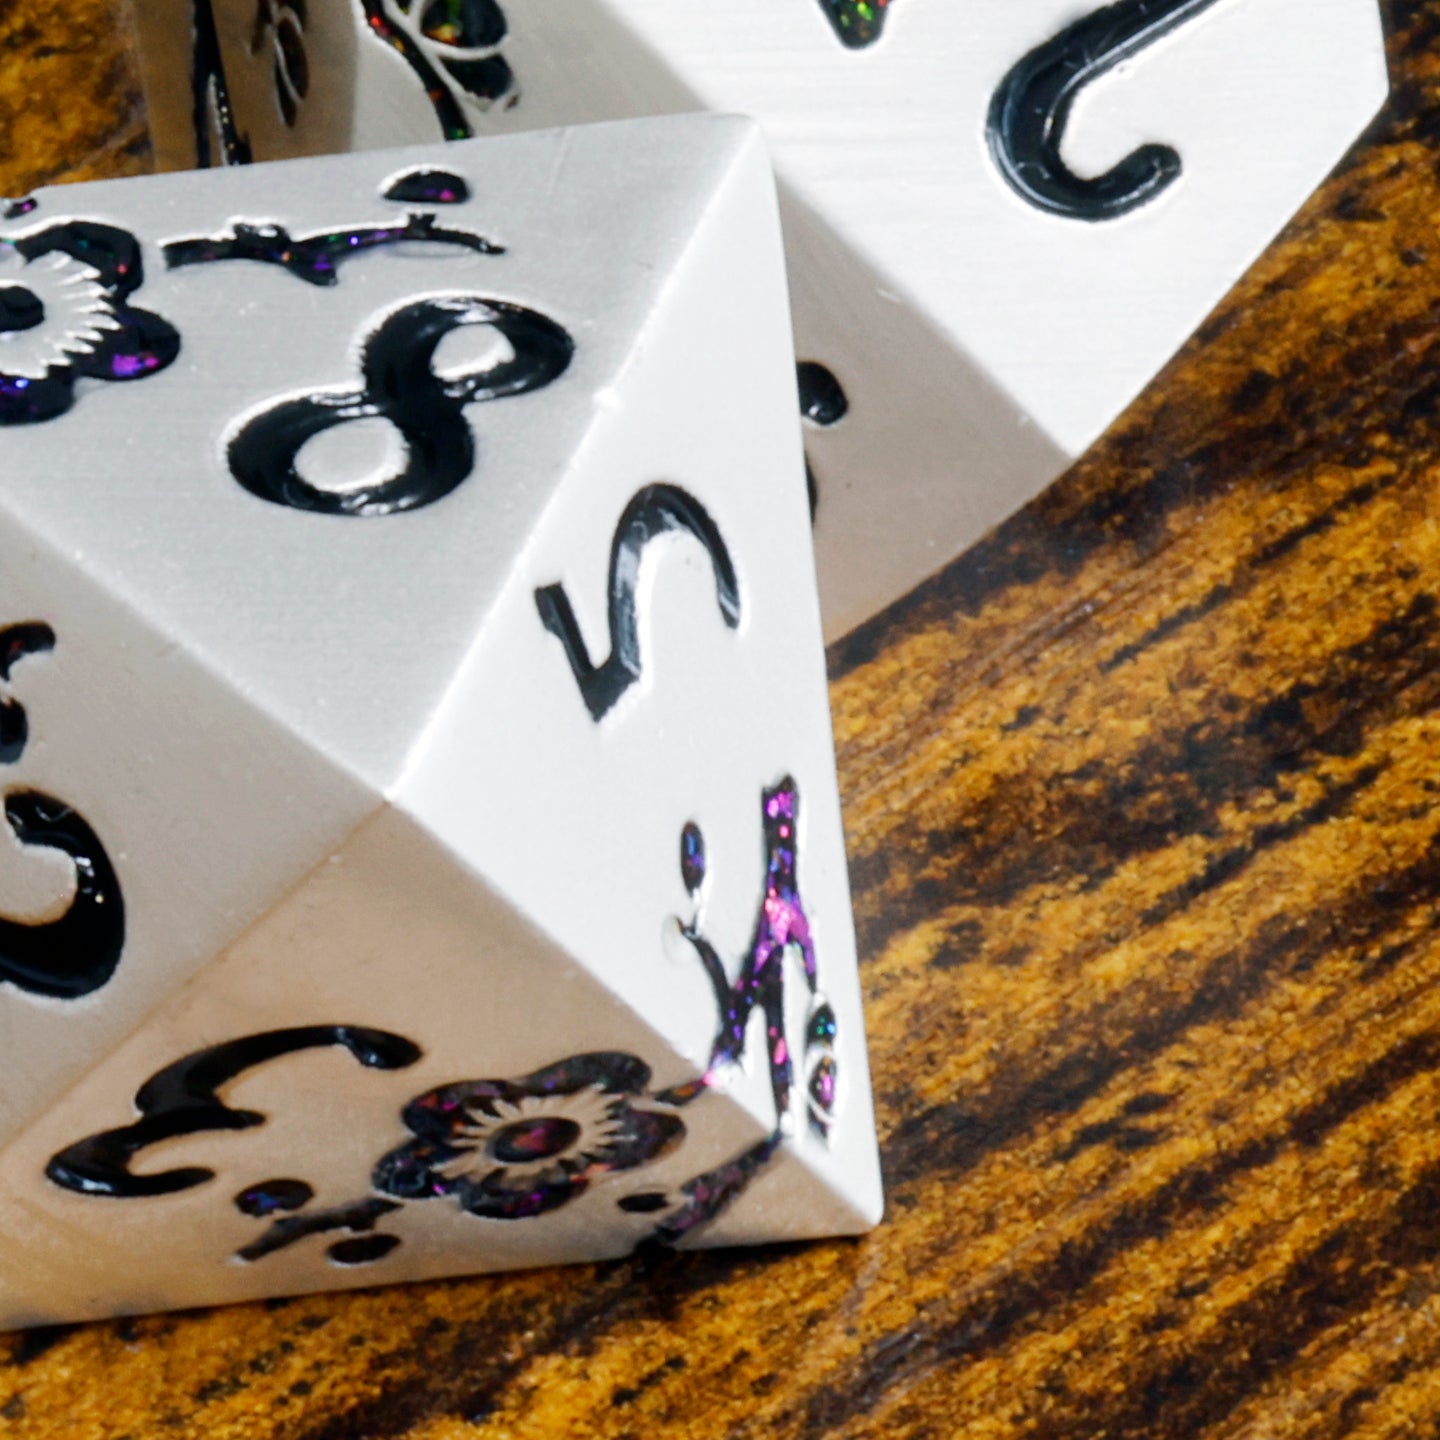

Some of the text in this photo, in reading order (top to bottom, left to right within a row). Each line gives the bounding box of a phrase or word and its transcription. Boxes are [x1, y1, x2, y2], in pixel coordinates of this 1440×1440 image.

[222, 296, 576, 518] 8
[534, 480, 744, 724] 5
[44, 1022, 426, 1198] 3
